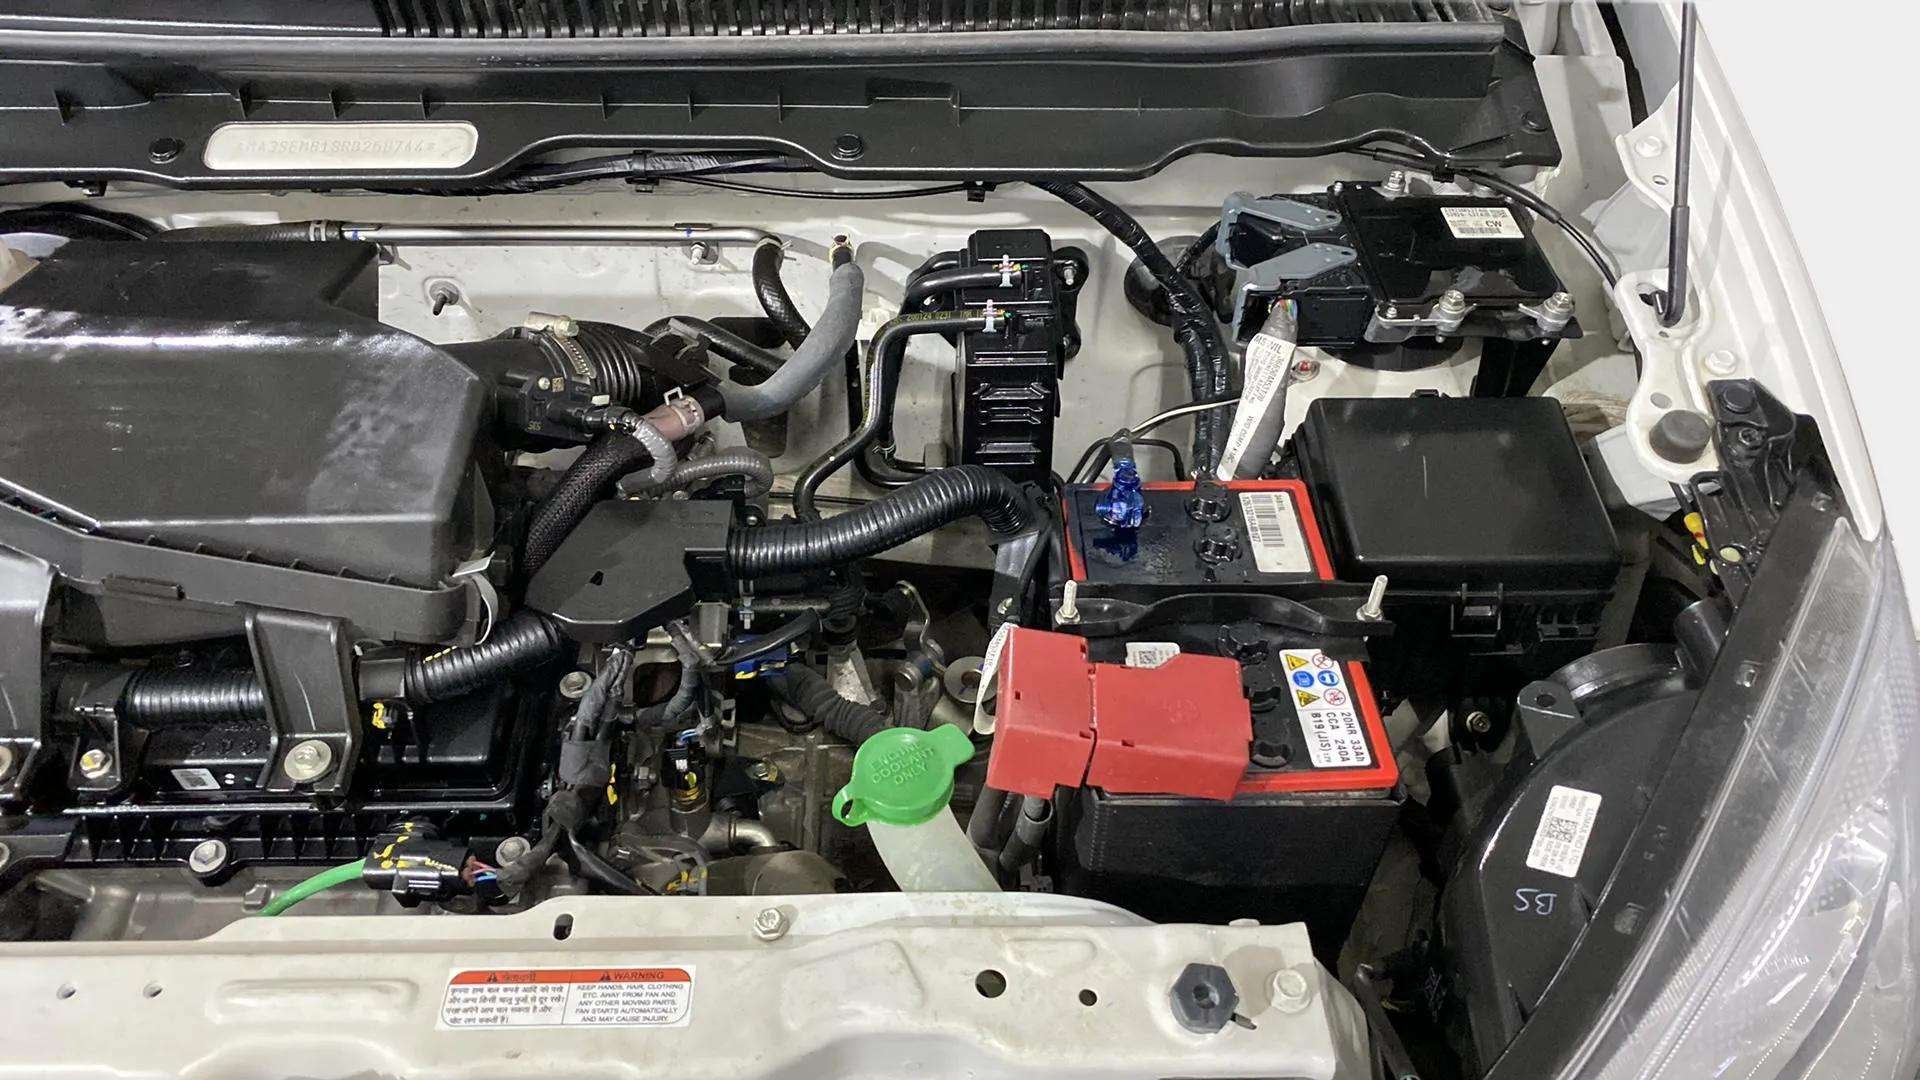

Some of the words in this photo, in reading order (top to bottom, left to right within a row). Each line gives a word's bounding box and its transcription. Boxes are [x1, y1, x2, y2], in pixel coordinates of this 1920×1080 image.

[1326, 712, 1339, 730] CCA
[1334, 739, 1350, 762] 240A
[1340, 712, 1357, 735] 20HR
[1350, 740, 1365, 762] 33Ah
[872, 748, 934, 784] COOLANT
[895, 762, 928, 784] ONLY
[614, 971, 664, 980] WARNING
